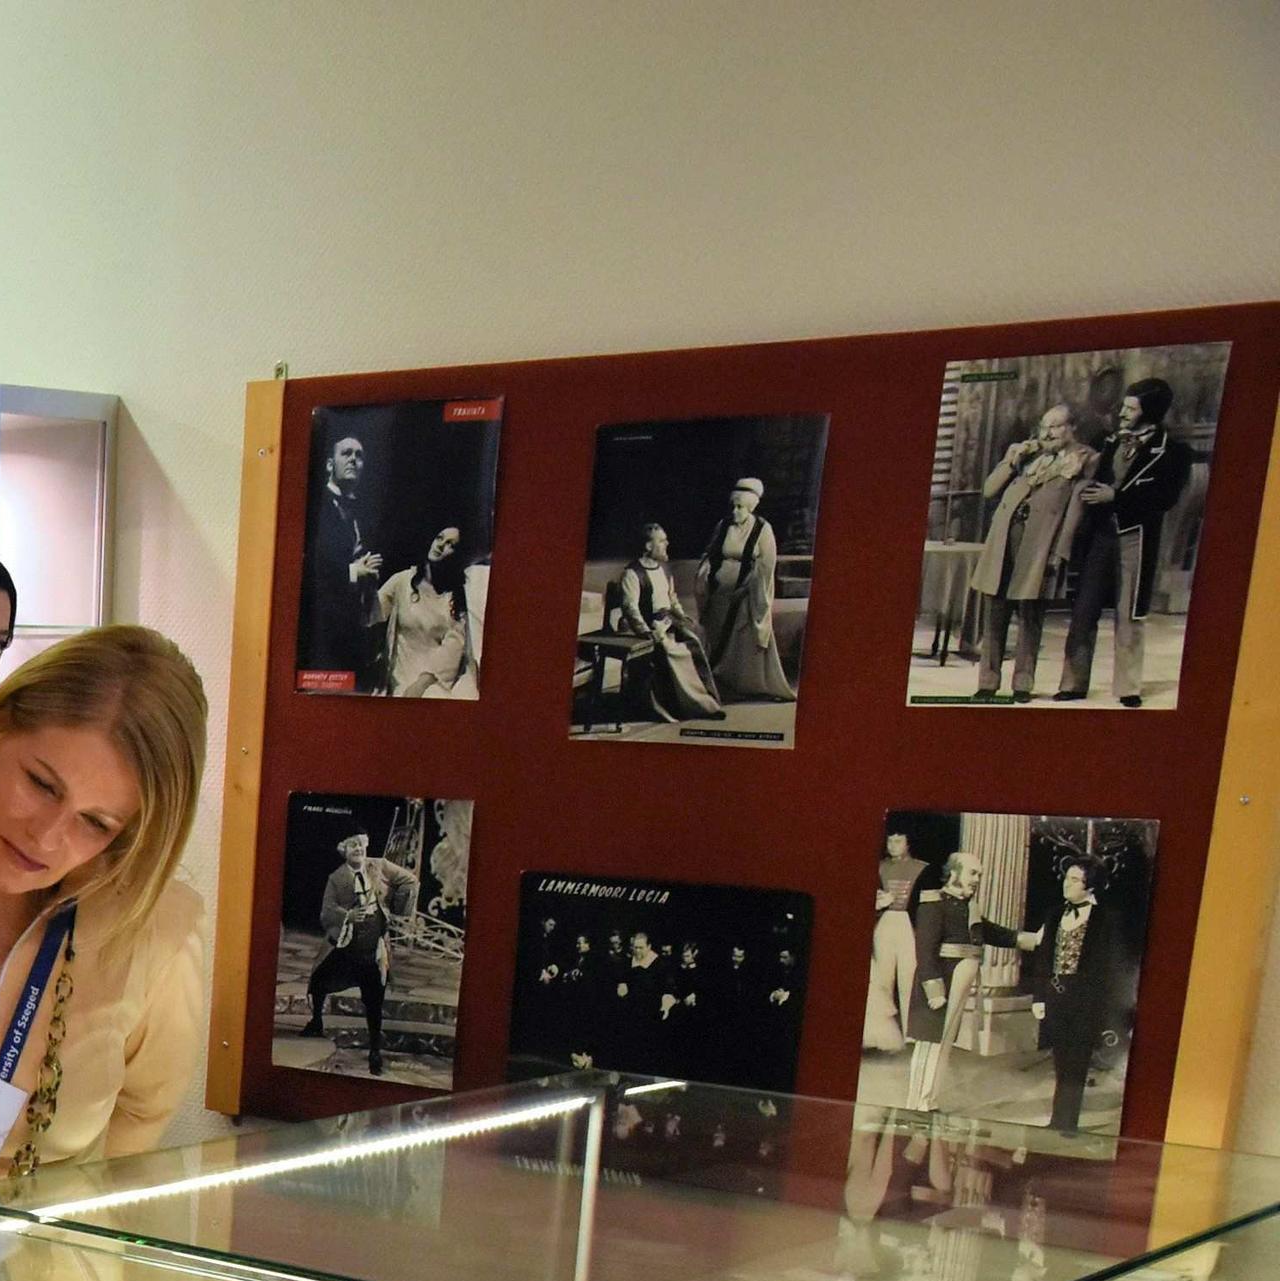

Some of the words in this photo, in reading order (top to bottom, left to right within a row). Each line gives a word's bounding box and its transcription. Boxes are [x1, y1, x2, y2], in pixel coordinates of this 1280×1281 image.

[538, 879, 626, 899] LAMMERMOORI
[628, 889, 671, 904] LUCIA
[18, 986, 40, 1030] Szeged
